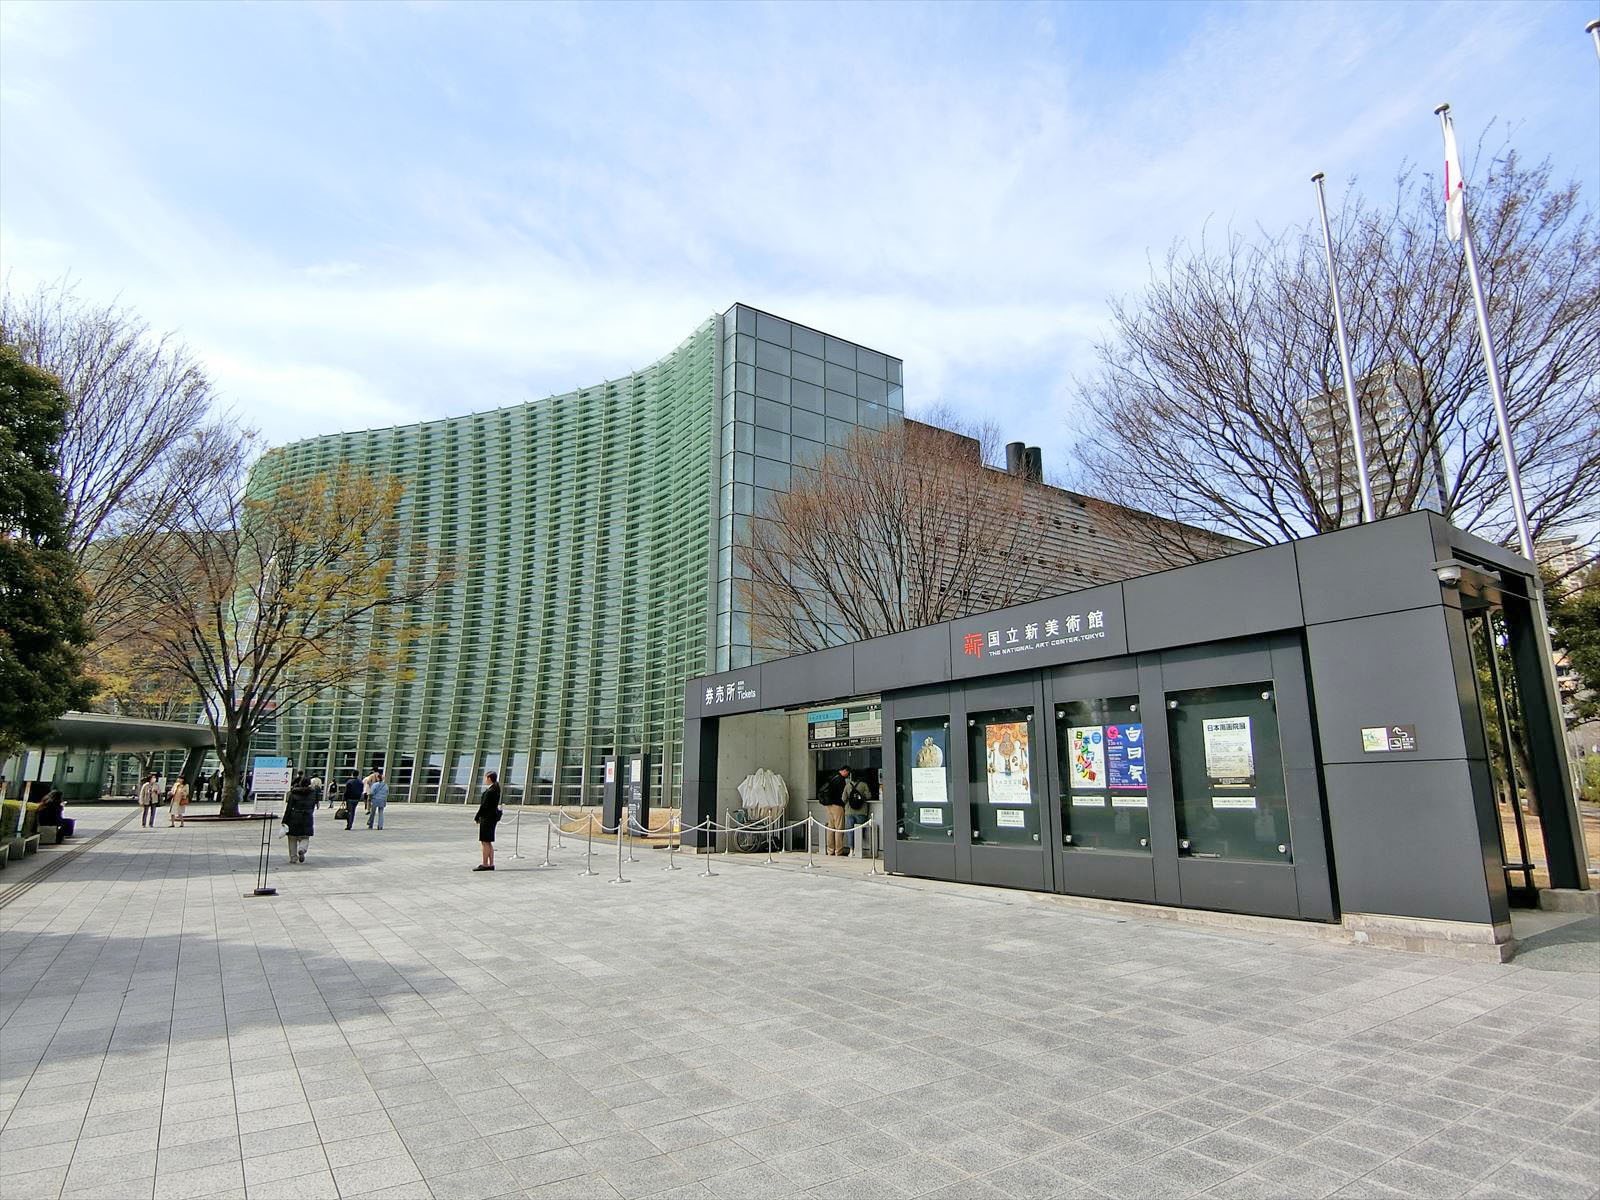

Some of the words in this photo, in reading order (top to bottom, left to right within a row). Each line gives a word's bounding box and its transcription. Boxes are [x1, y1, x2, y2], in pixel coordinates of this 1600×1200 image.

[987, 609, 1104, 648] 国立新美術館
[1001, 644, 1034, 655] NATIONAL
[1035, 641, 1049, 650] ART
[705, 682, 736, 706] 券売所
[737, 689, 756, 700] Tickets
